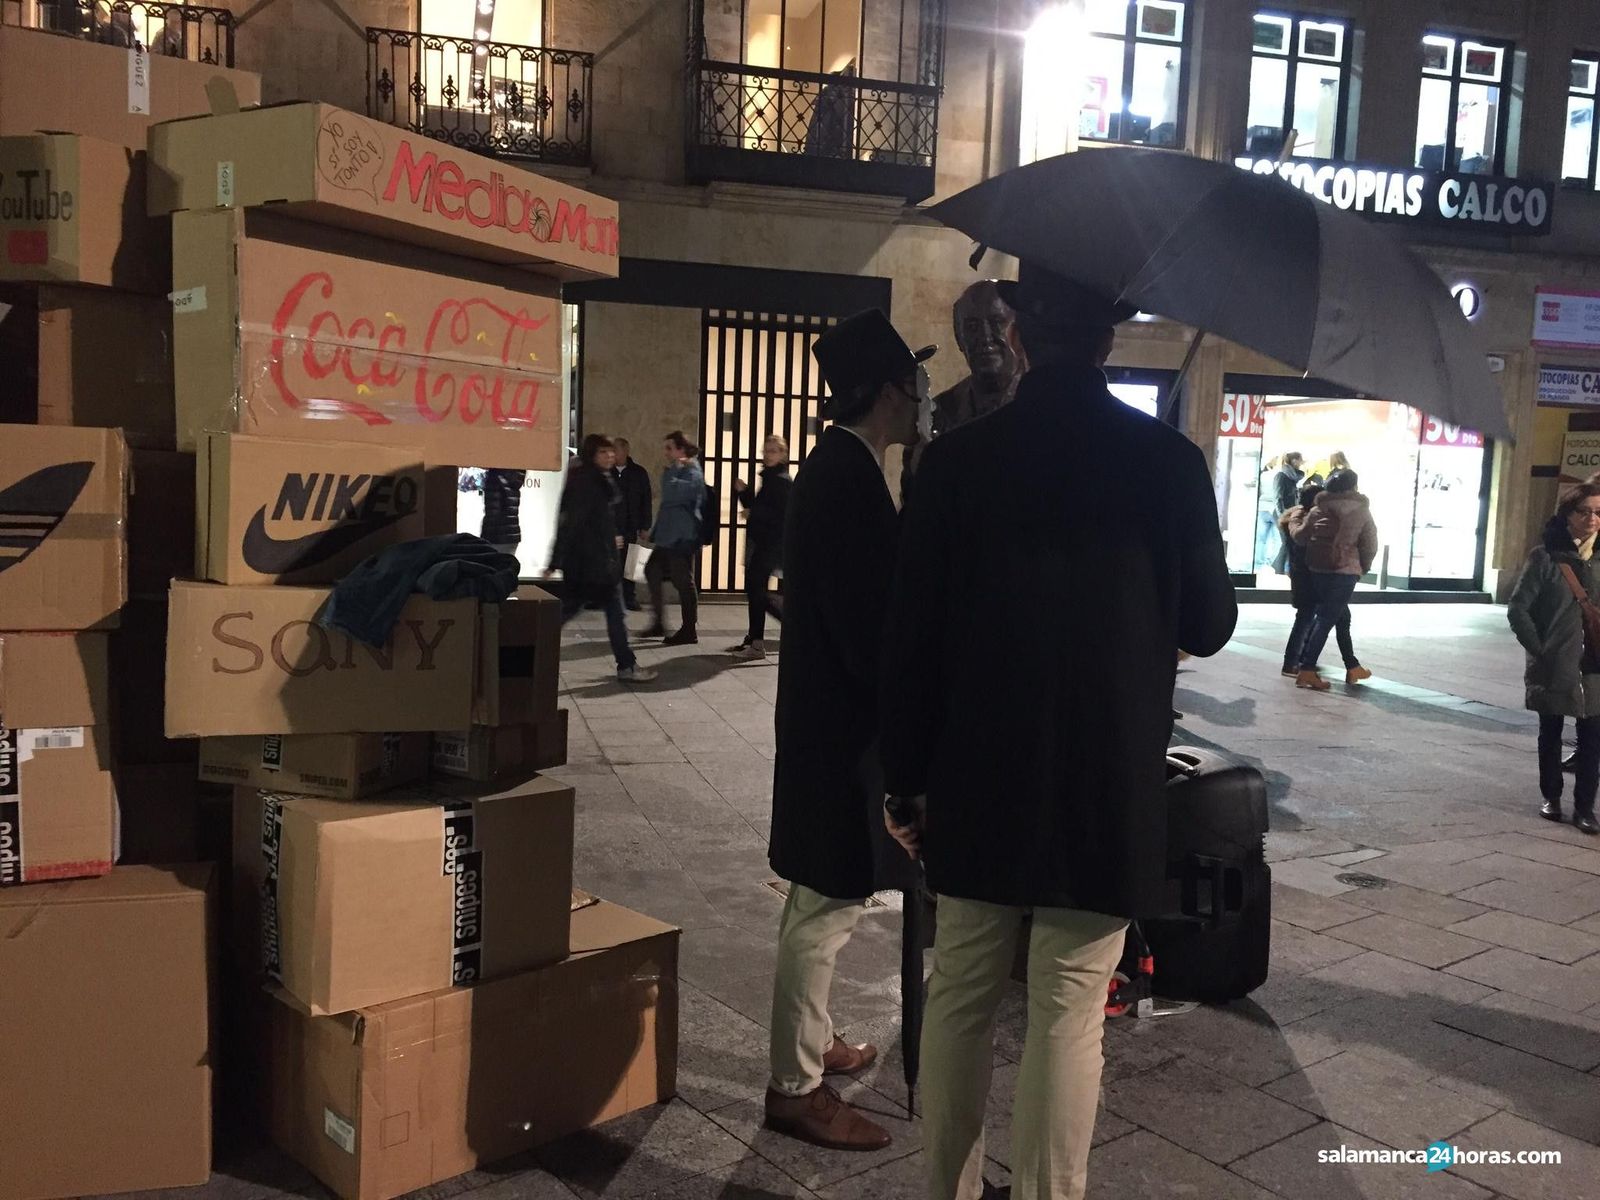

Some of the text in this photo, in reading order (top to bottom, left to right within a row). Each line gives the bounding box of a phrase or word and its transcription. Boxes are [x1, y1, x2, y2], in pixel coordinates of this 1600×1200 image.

[0, 169, 73, 222] ouTube
[1438, 178, 1548, 227] CALCO
[271, 271, 408, 426] Coca
